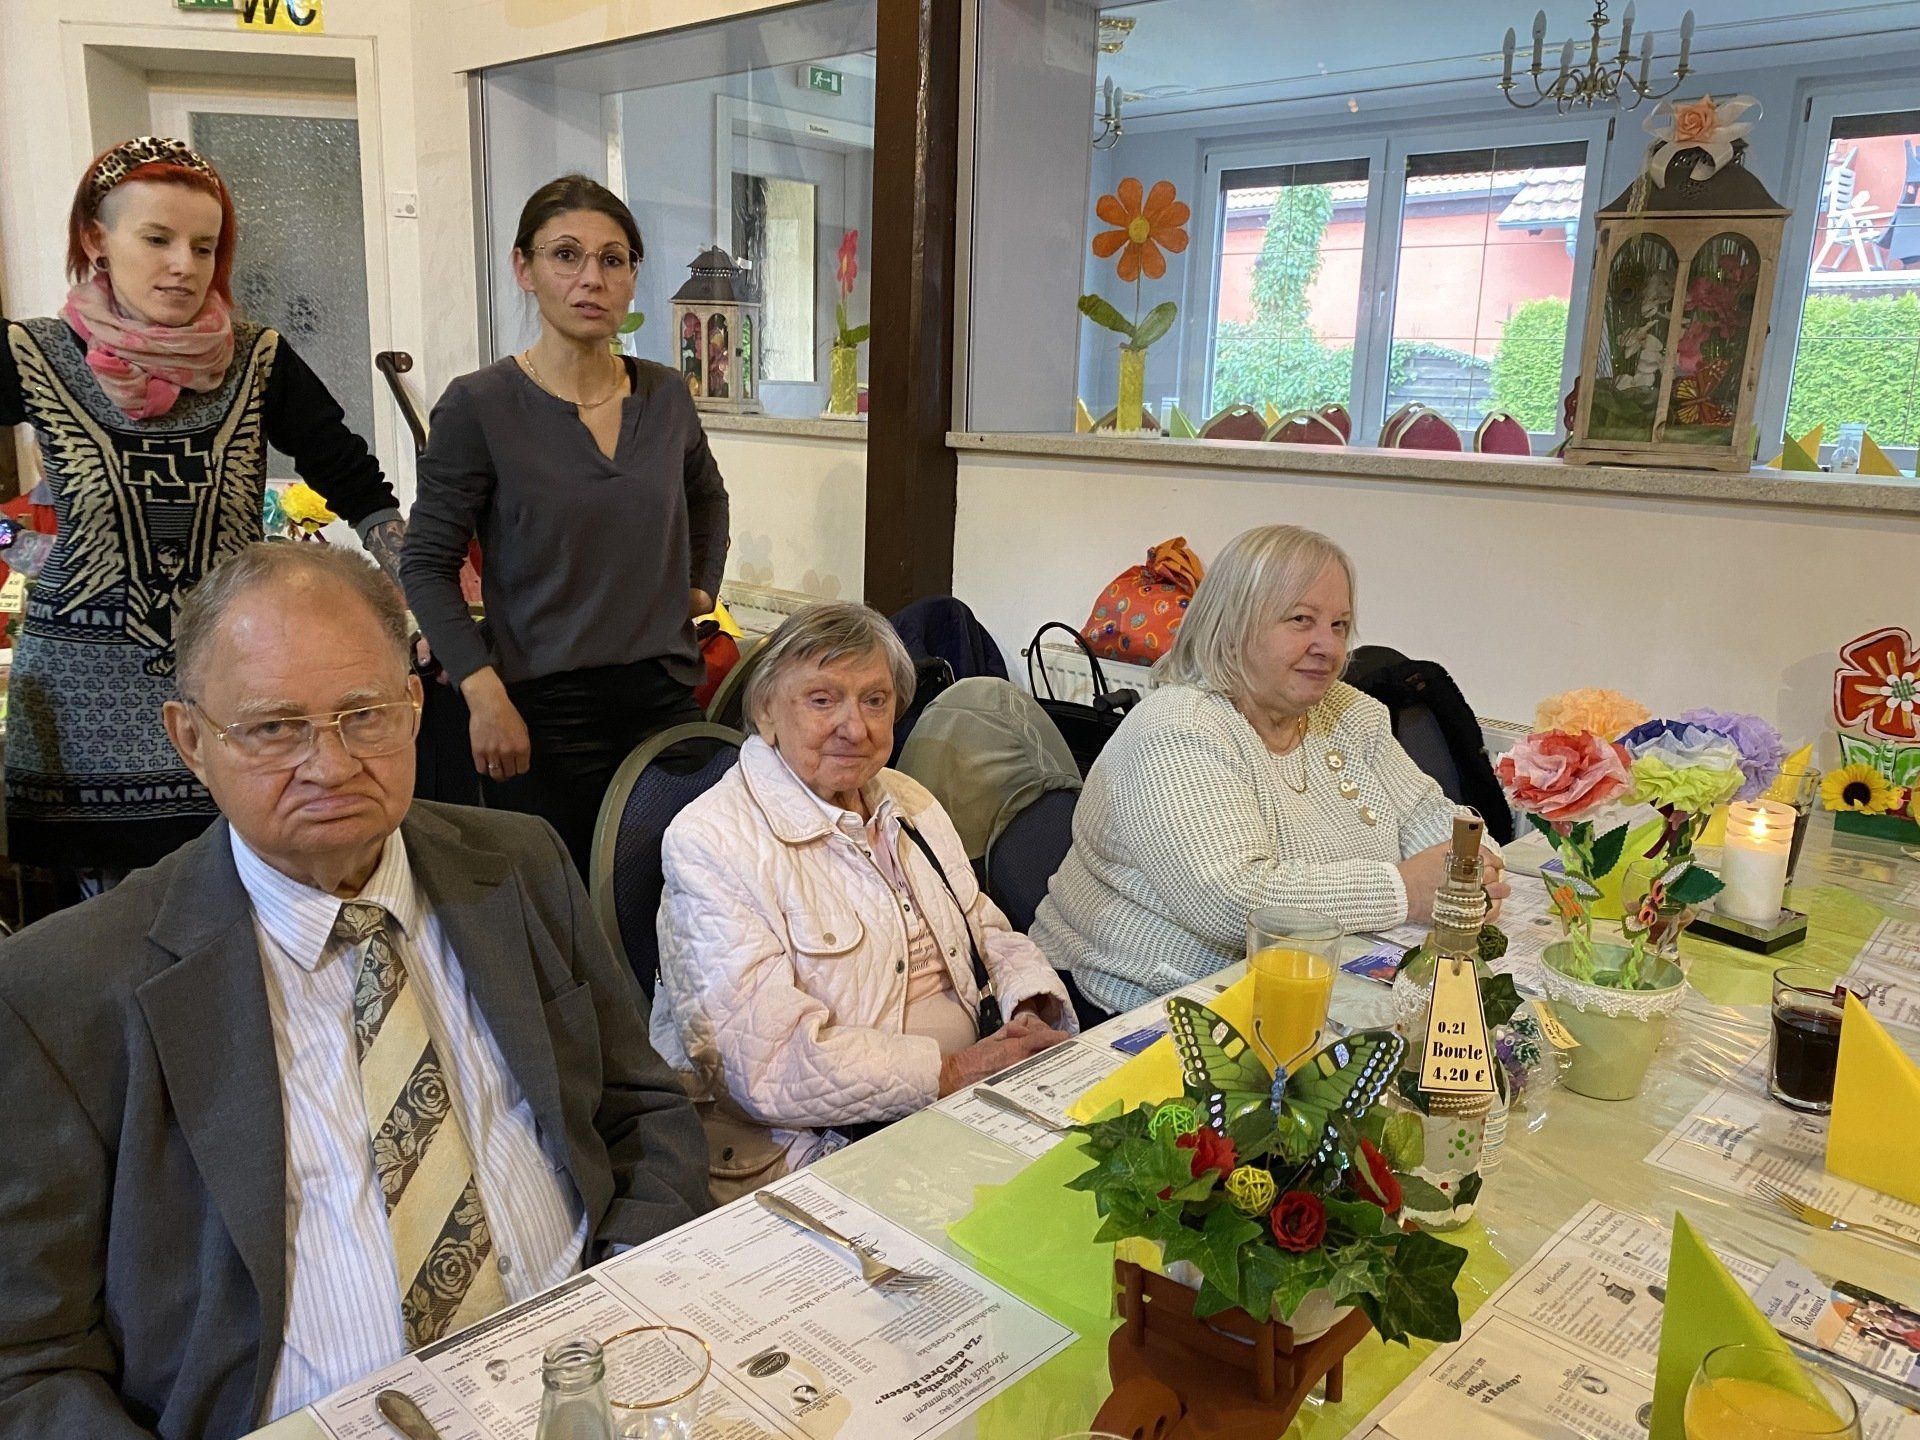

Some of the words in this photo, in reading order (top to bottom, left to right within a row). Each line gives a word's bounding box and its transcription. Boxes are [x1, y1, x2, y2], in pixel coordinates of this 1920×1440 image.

[244, 0, 316, 26] WC
[1432, 1041, 1483, 1060] Bowle
[1432, 1066, 1469, 1083] 4,20
[1475, 1069, 1485, 1083] €
[952, 1302, 1001, 1333] Alkoholfreie
[914, 1331, 956, 1357] Getränke
[943, 1350, 964, 1365] den
[969, 1351, 1009, 1379] Herzlich
[912, 1358, 974, 1398] Landgasthof
[918, 1364, 948, 1383] Drei
[914, 1377, 973, 1413] Willkommen
[900, 1411, 920, 1423] im
